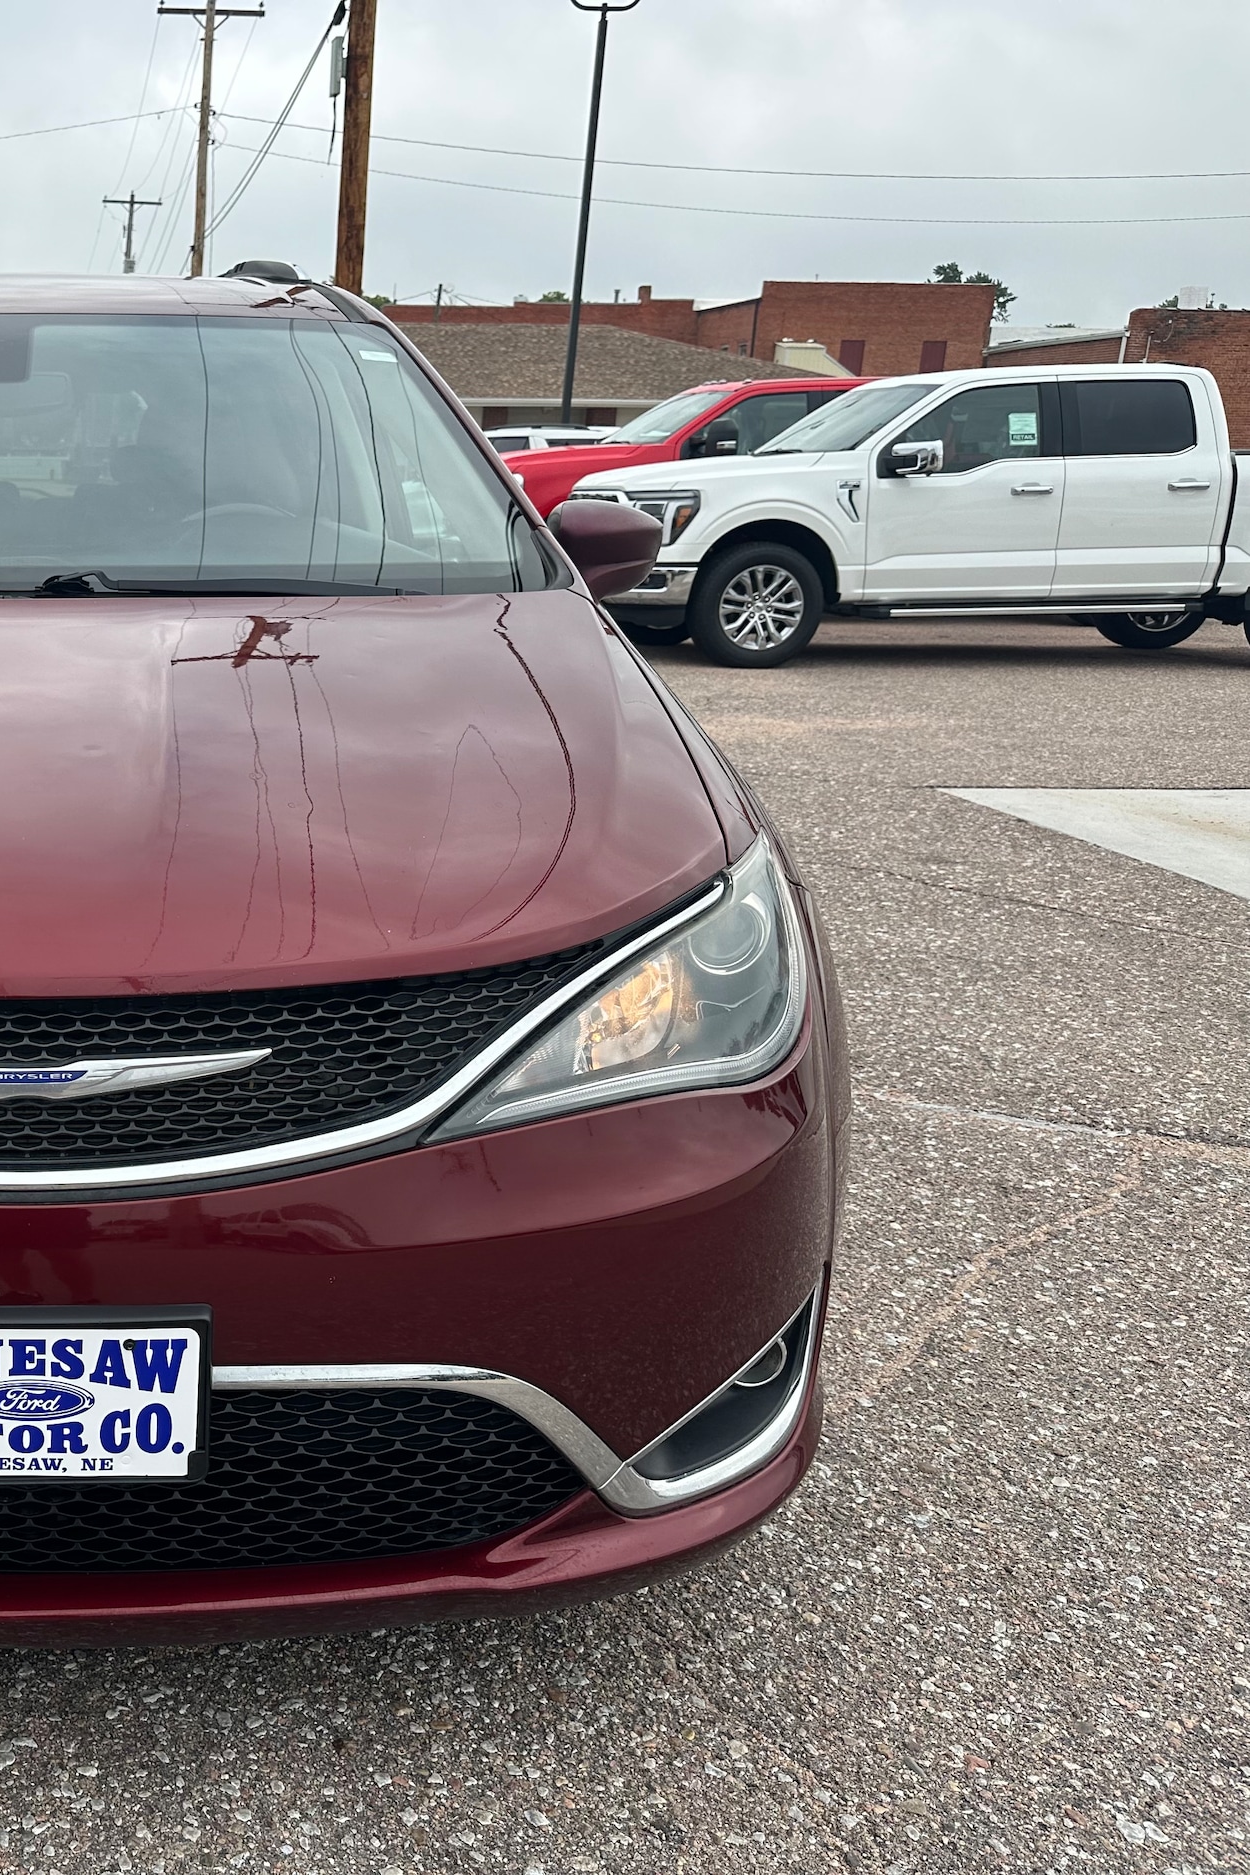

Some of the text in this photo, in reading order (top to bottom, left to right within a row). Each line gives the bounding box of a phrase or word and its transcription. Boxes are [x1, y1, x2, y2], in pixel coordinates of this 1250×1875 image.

[0, 1388, 61, 1413] Ford
[100, 1402, 185, 1455] CO.
[81, 1457, 114, 1471] NE
